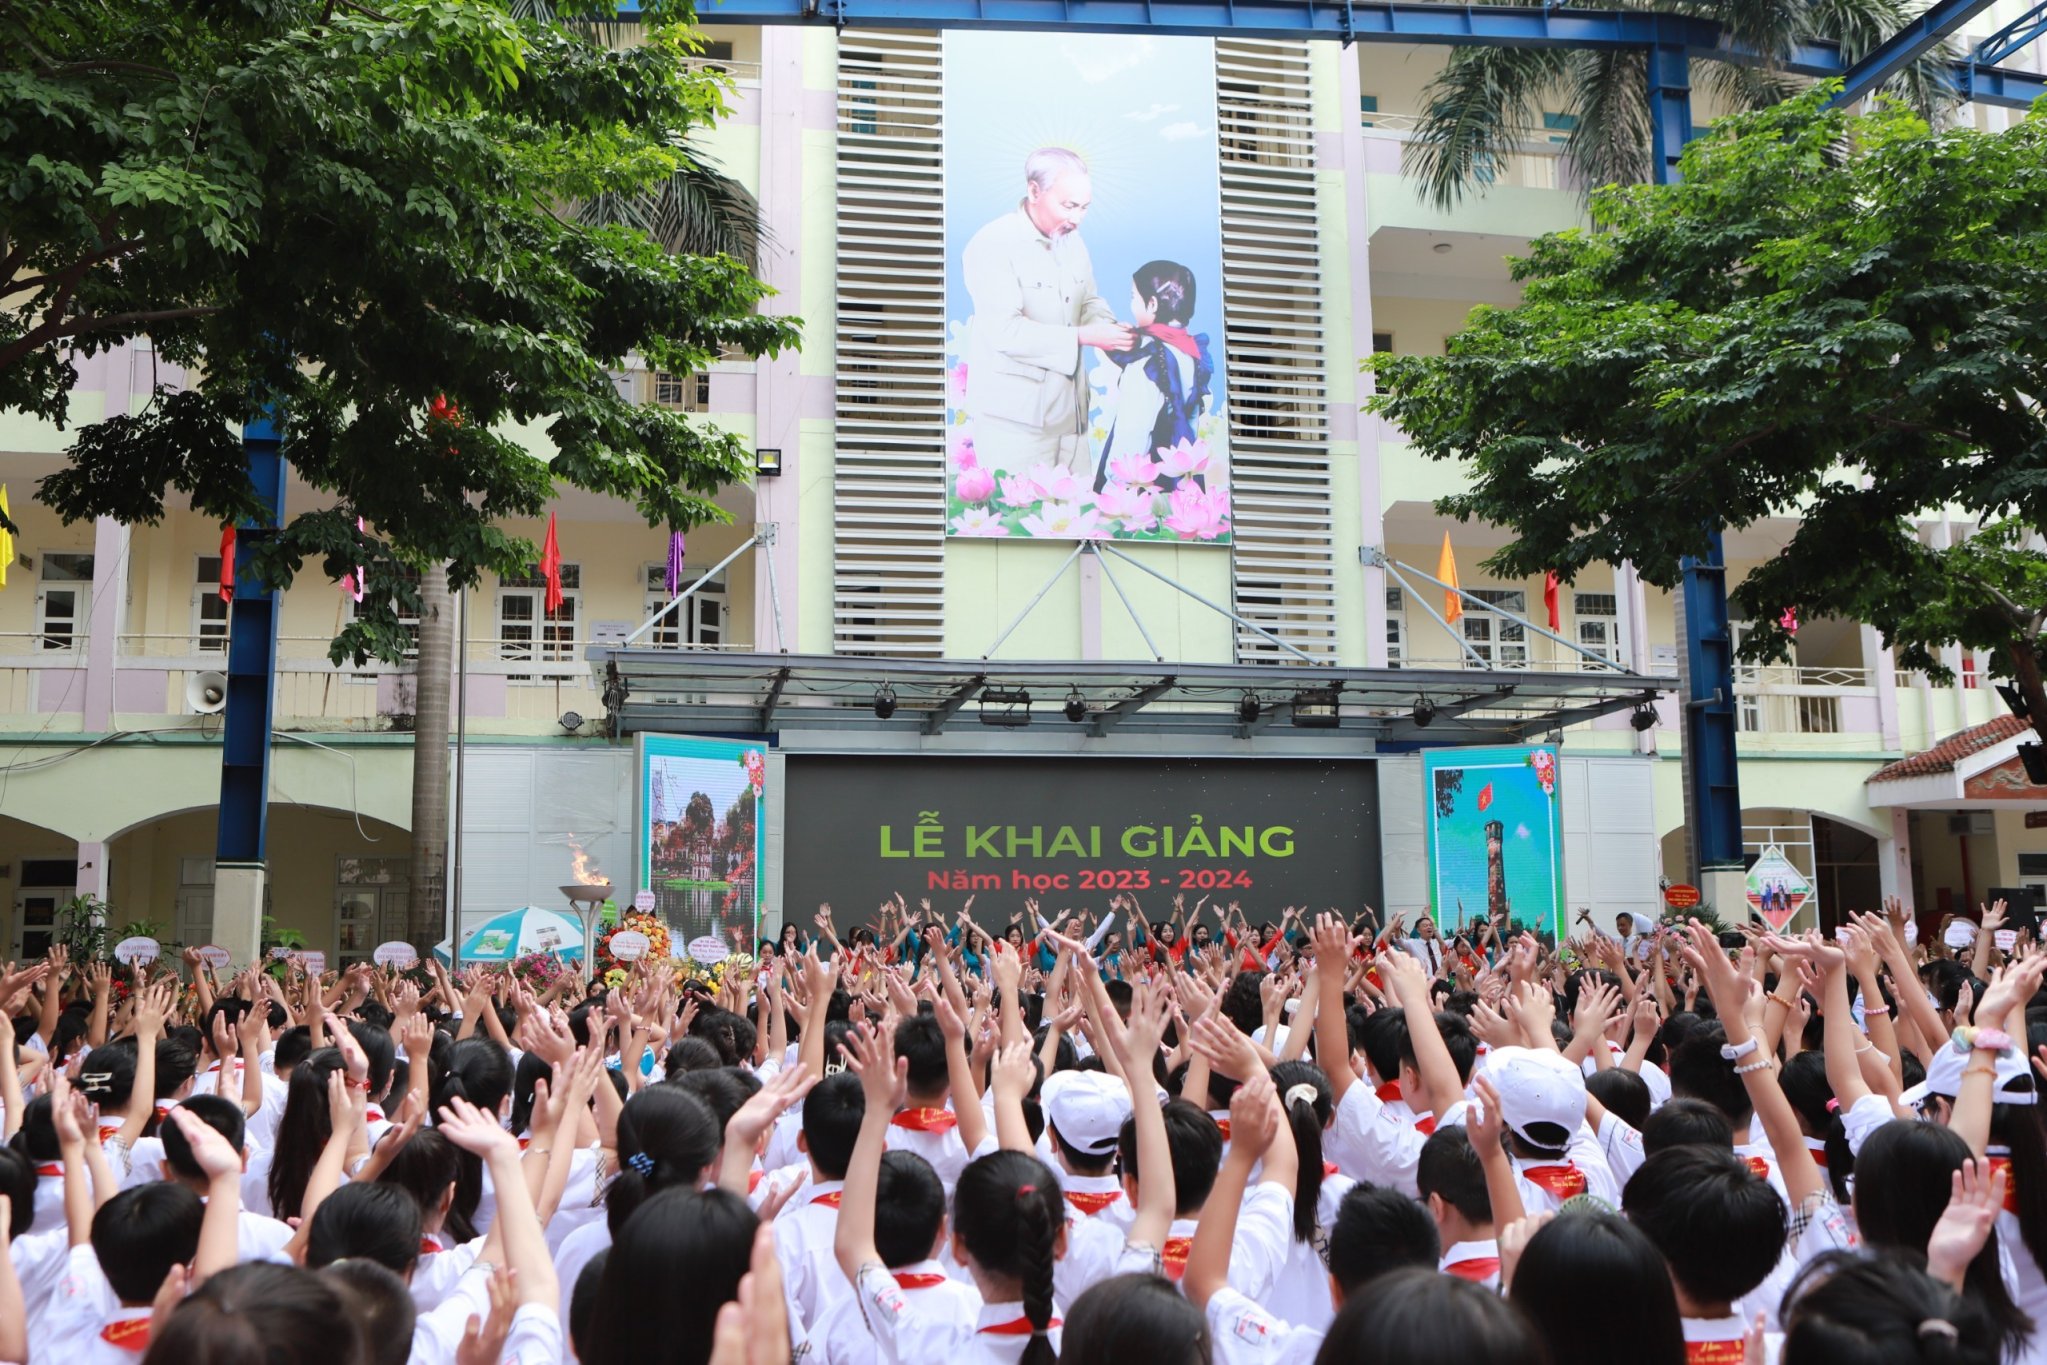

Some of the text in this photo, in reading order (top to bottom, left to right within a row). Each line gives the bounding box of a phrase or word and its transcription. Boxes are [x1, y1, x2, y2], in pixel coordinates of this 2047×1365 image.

[879, 811, 1296, 859] LỄ KHAI GIẢNG
[927, 869, 1002, 890] Năm
[1011, 869, 1070, 895] học
[1078, 868, 1152, 890] 2023
[1179, 868, 1253, 890] 2024
